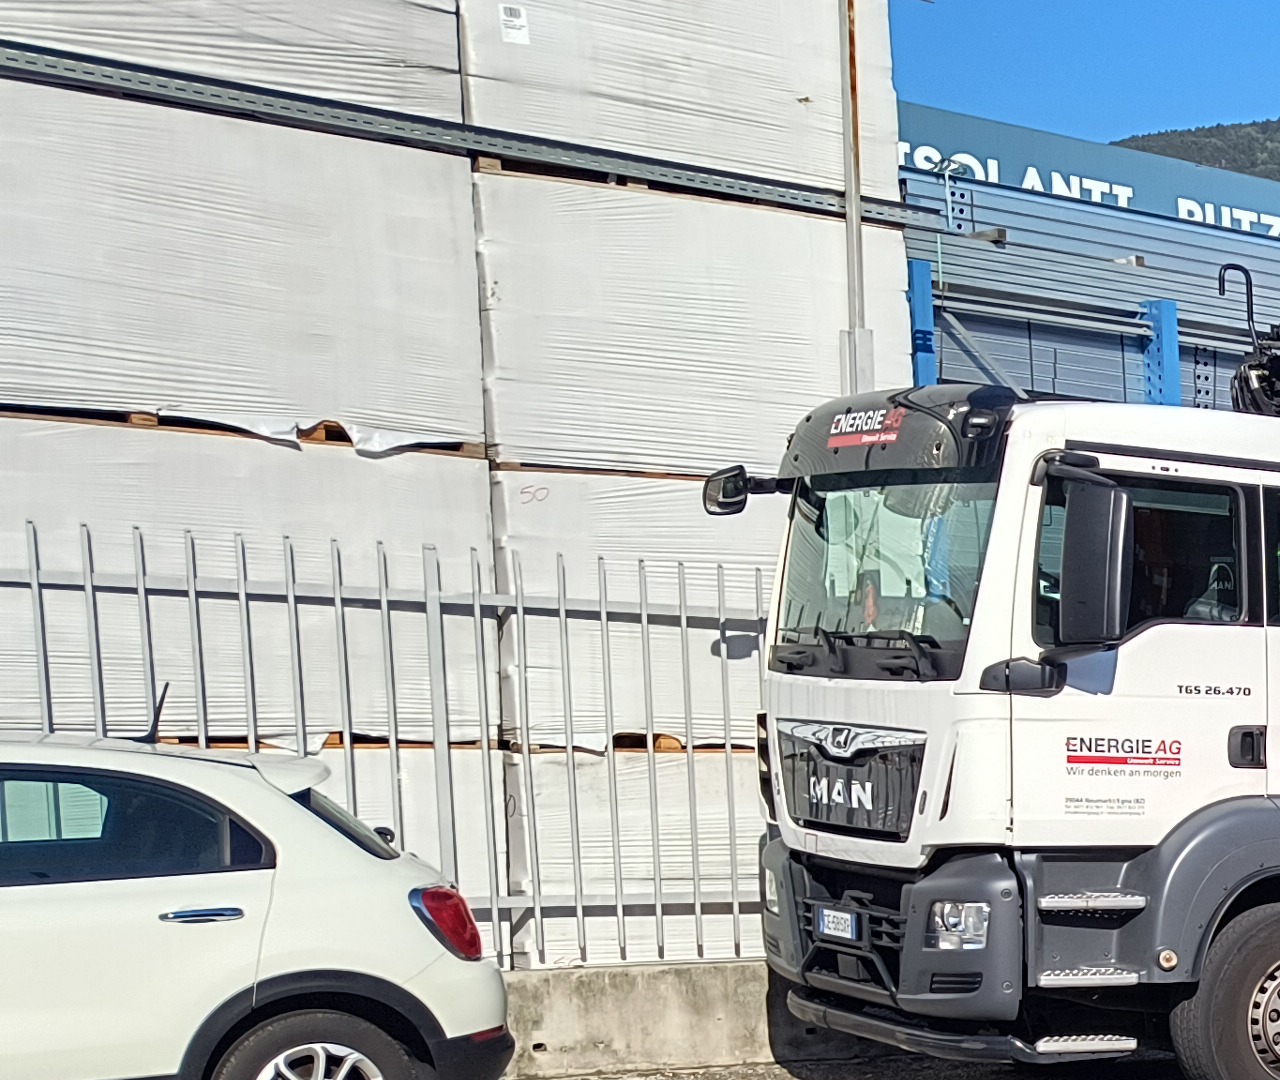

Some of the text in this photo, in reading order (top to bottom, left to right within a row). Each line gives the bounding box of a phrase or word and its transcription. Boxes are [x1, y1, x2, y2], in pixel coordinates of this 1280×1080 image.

[830, 409, 887, 434] ENERGIE
[519, 484, 549, 505] 50
[1176, 684, 1252, 697] TGS 26.470
[1065, 736, 1182, 755] ENERGIE AG
[1065, 766, 1182, 780] Wir denken an morgen
[809, 776, 873, 810] MAN
